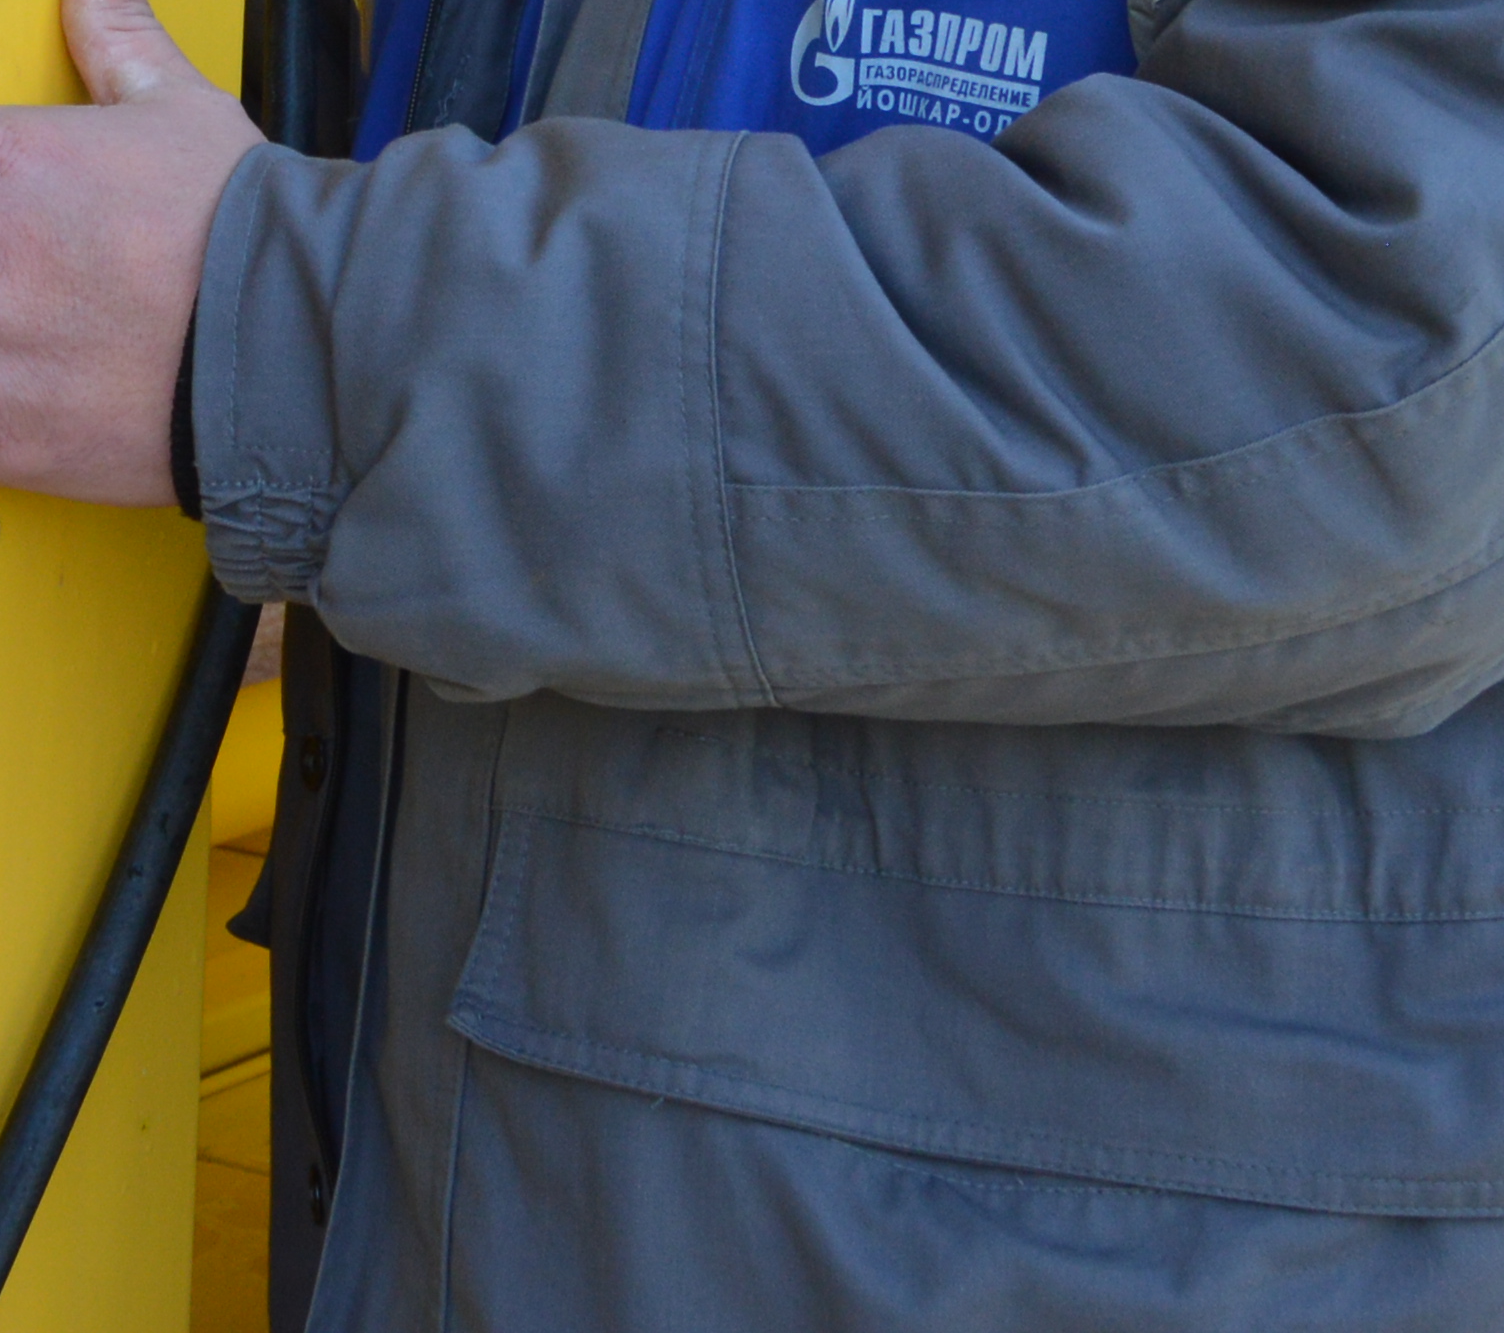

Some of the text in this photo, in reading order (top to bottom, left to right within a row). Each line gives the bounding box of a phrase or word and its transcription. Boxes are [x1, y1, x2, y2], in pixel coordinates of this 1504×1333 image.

[860, 7, 1048, 82] ГАЗПРОМ
[856, 83, 1013, 136] ЙОШКАР-ОЛ
[866, 64, 1032, 108] ГАЗОРАСПРЕДЕЛЕНИЕ
